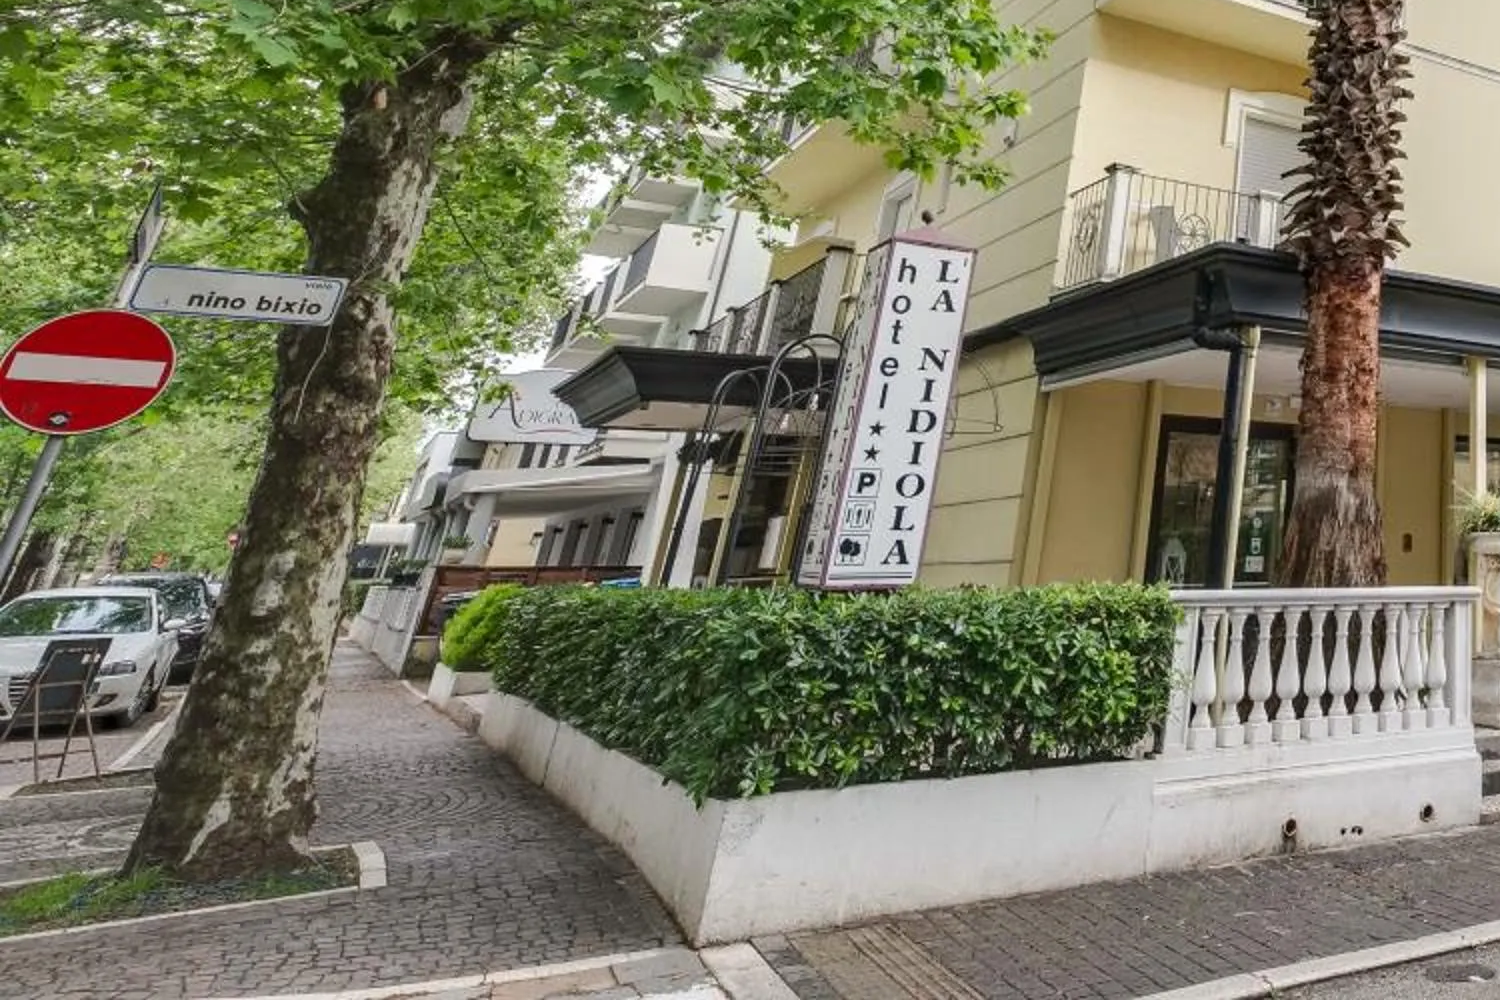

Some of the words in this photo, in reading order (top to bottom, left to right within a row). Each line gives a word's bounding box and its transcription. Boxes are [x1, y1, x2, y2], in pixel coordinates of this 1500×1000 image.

[186, 291, 246, 310] nino
[255, 295, 322, 315] bixio
[879, 257, 917, 409] hotel
[930, 259, 960, 313] LA
[880, 347, 951, 565] NIDIOLA
